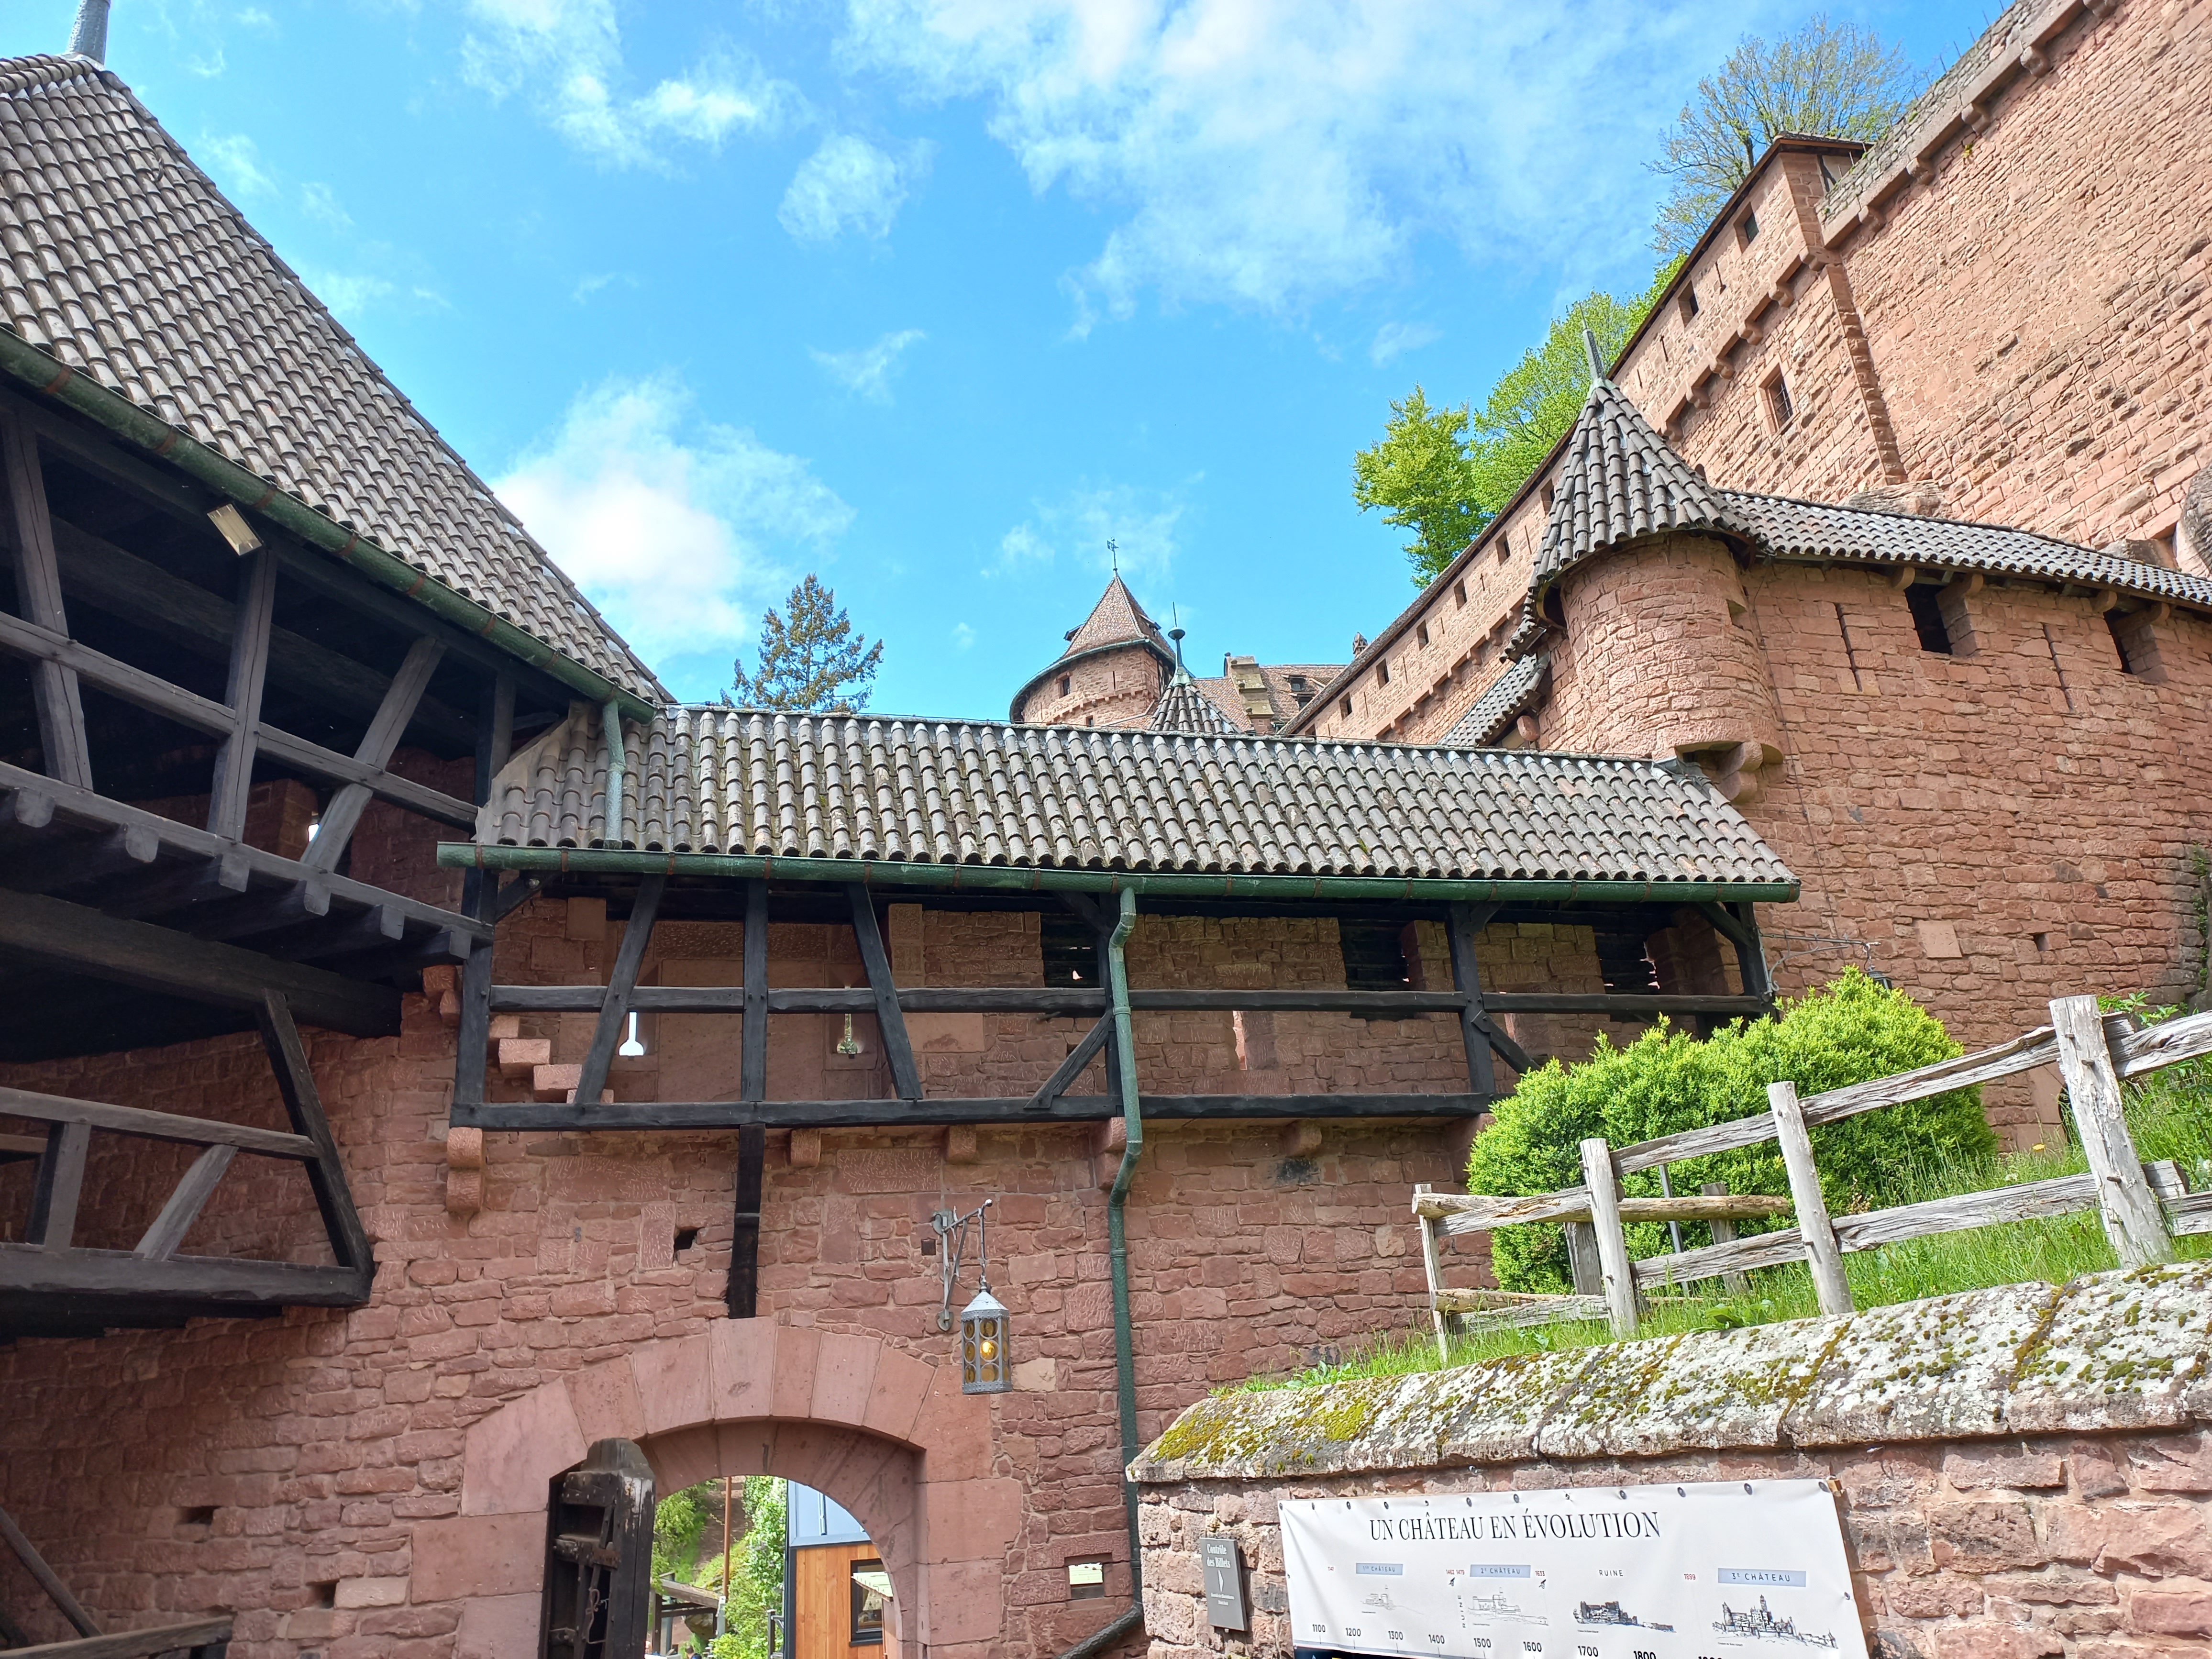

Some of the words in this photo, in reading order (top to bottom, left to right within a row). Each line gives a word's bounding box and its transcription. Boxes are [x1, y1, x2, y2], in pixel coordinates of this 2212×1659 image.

[1370, 1519, 1393, 1540] UN
[1399, 1512, 1483, 1540] CHÂTEAU
[1490, 1515, 1516, 1539] EN
[1522, 1508, 1660, 1538] ÉVOLUTION
[1207, 1543, 1227, 1555] Contrôle
[1207, 1556, 1215, 1567] des
[1215, 1557, 1231, 1568] Billets
[1745, 1572, 1791, 1582] CHÂTEAU
[1312, 1624, 1326, 1633] 1100
[1346, 1627, 1361, 1637] 1200
[1388, 1631, 1404, 1640] 1300
[1428, 1634, 1445, 1644] 1400
[1473, 1637, 1491, 1648] 1500
[1523, 1641, 1542, 1652] 1600
[1578, 1646, 1599, 1657] 1700
